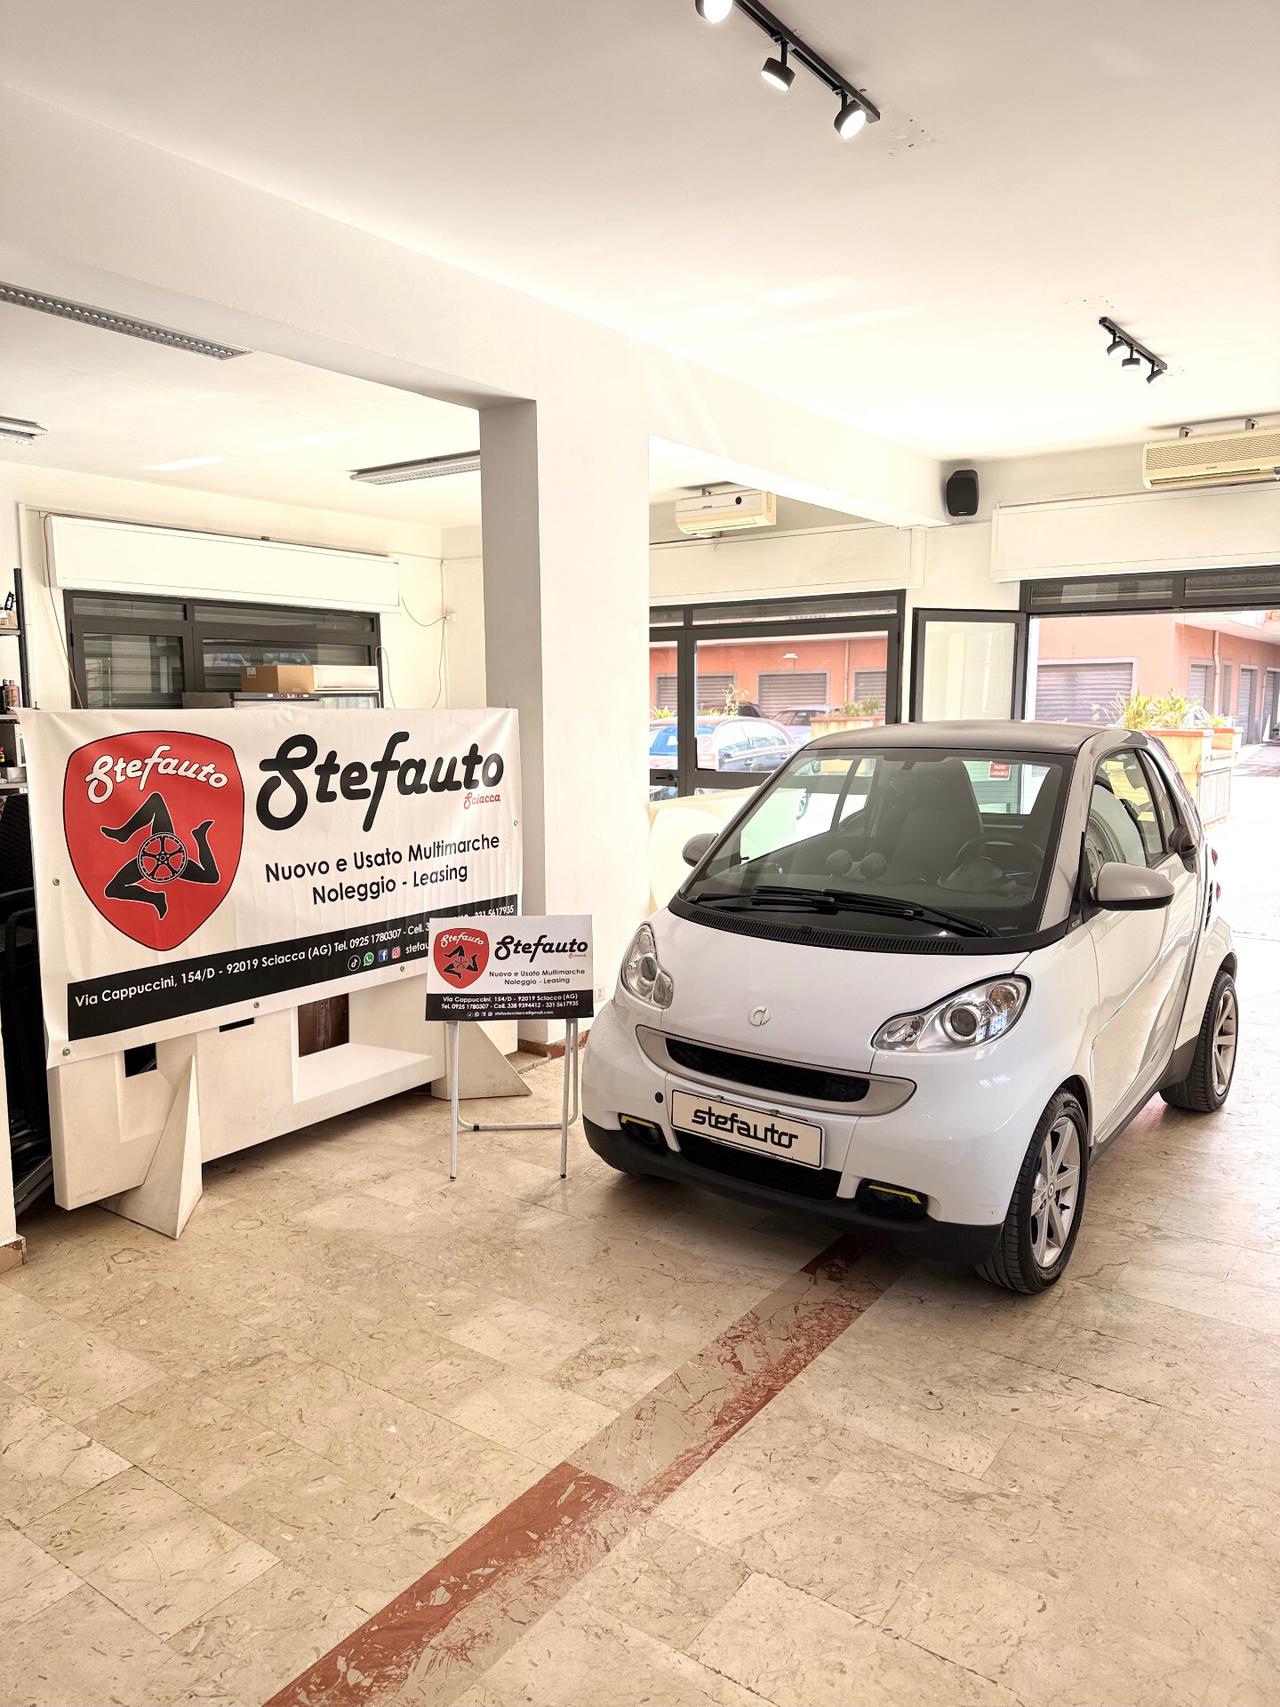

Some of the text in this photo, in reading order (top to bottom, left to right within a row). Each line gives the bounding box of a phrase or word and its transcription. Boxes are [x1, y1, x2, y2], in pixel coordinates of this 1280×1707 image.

[85, 744, 229, 804] Stefauto
[256, 731, 504, 832] Stefauto
[463, 791, 502, 810] Sciacca
[265, 834, 500, 883] Nuovo e Usato Multimarche
[312, 875, 397, 905] Noleggio
[413, 864, 468, 887] Leasing
[440, 932, 484, 948] Stefauto
[494, 935, 588, 963] Stefauto
[75, 995, 98, 1007] Via
[101, 976, 178, 1002] Cappuccini,
[181, 967, 215, 985] 154/D
[226, 958, 259, 975] 92019
[261, 950, 306, 968] Sciacca
[308, 943, 333, 960] (AG)
[334, 941, 349, 953] Tel.
[349, 935, 370, 950] 0925
[371, 928, 402, 945] 1780307
[407, 923, 424, 936] Cell.
[504, 978, 537, 986] Noleggio
[541, 968, 585, 976] Multimarche
[556, 1000, 578, 1008] 5617935
[691, 1106, 798, 1149] stefauto
